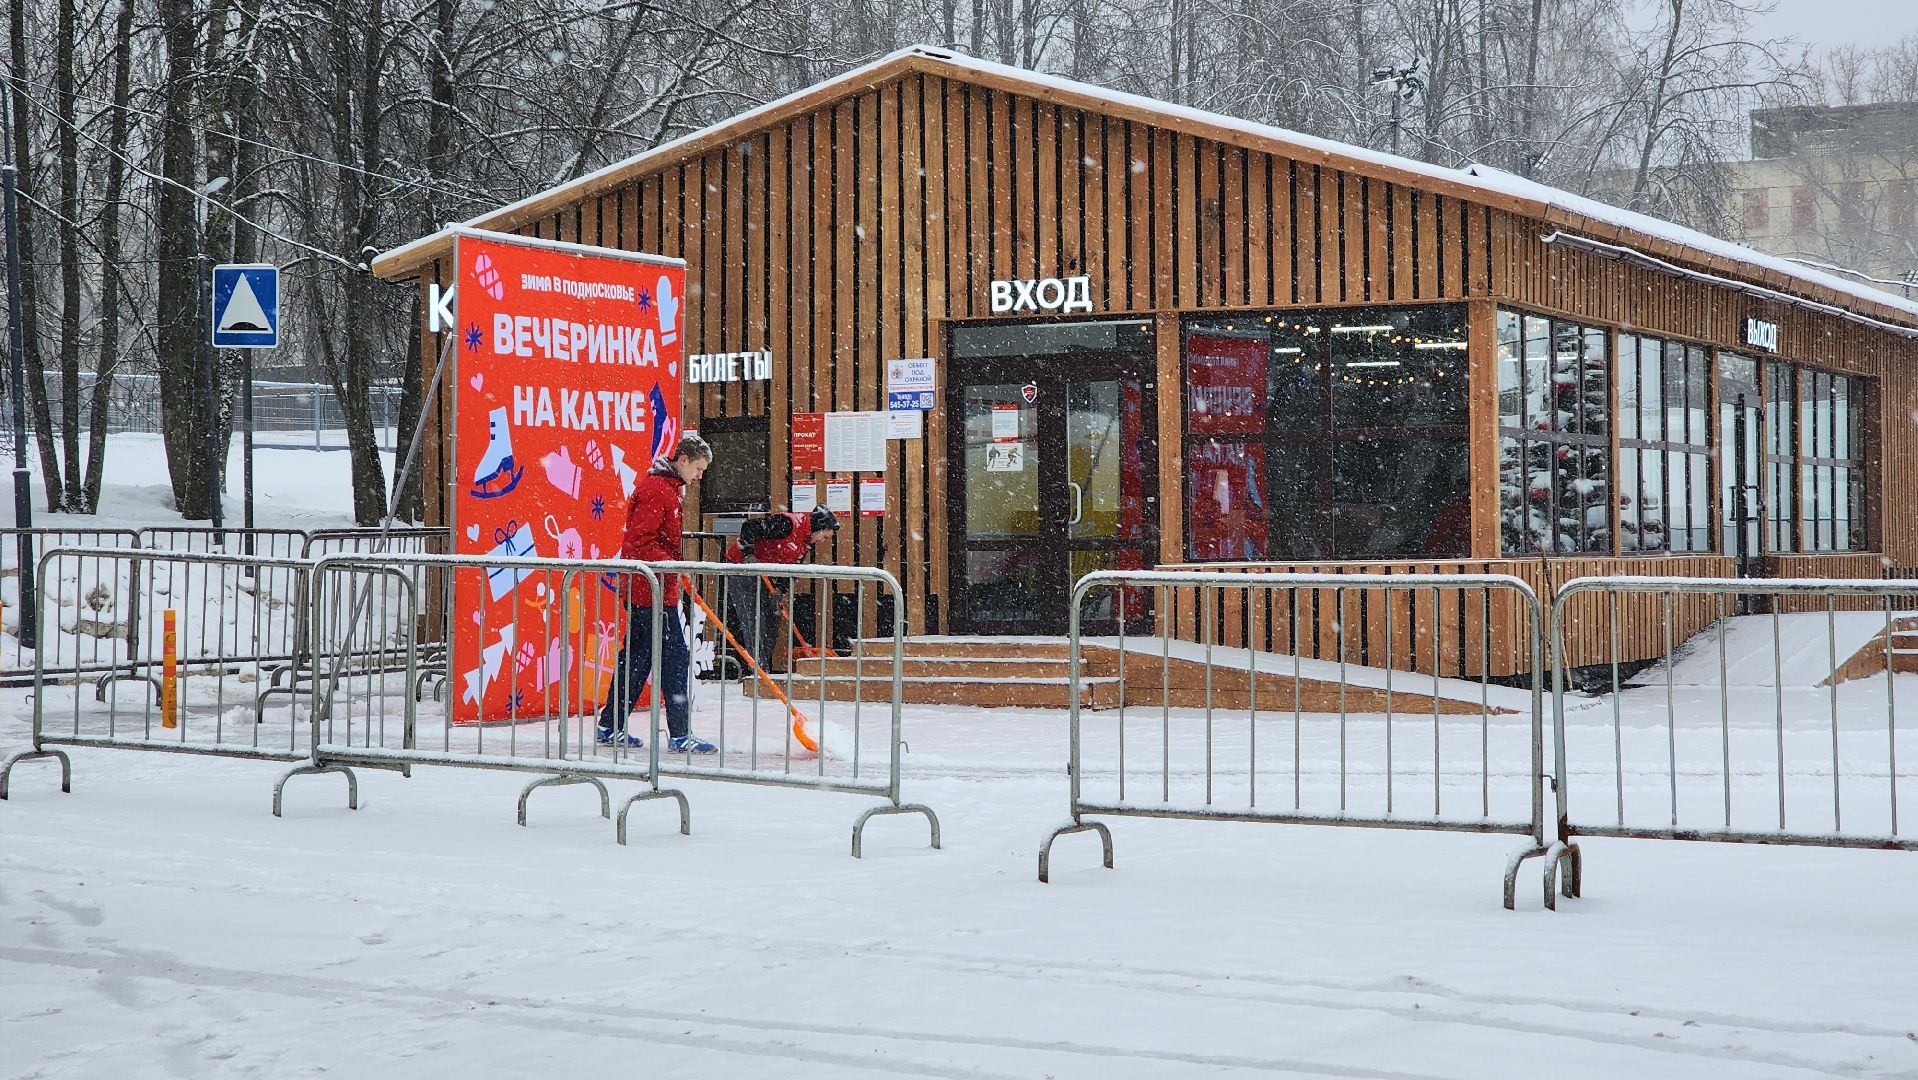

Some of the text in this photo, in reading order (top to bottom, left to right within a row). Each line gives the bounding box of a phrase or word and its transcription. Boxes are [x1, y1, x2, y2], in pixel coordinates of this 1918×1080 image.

[521, 274, 635, 302] ЗИМА В ПОДМОСКОВЬЕ
[991, 277, 1093, 313] ВХОД
[493, 314, 658, 367] ВЕЧЕРИНКА
[1747, 318, 1777, 352] ВЫХОД
[689, 351, 773, 384] БИЛЕТЫ
[513, 386, 645, 432] НА КАТКЕ
